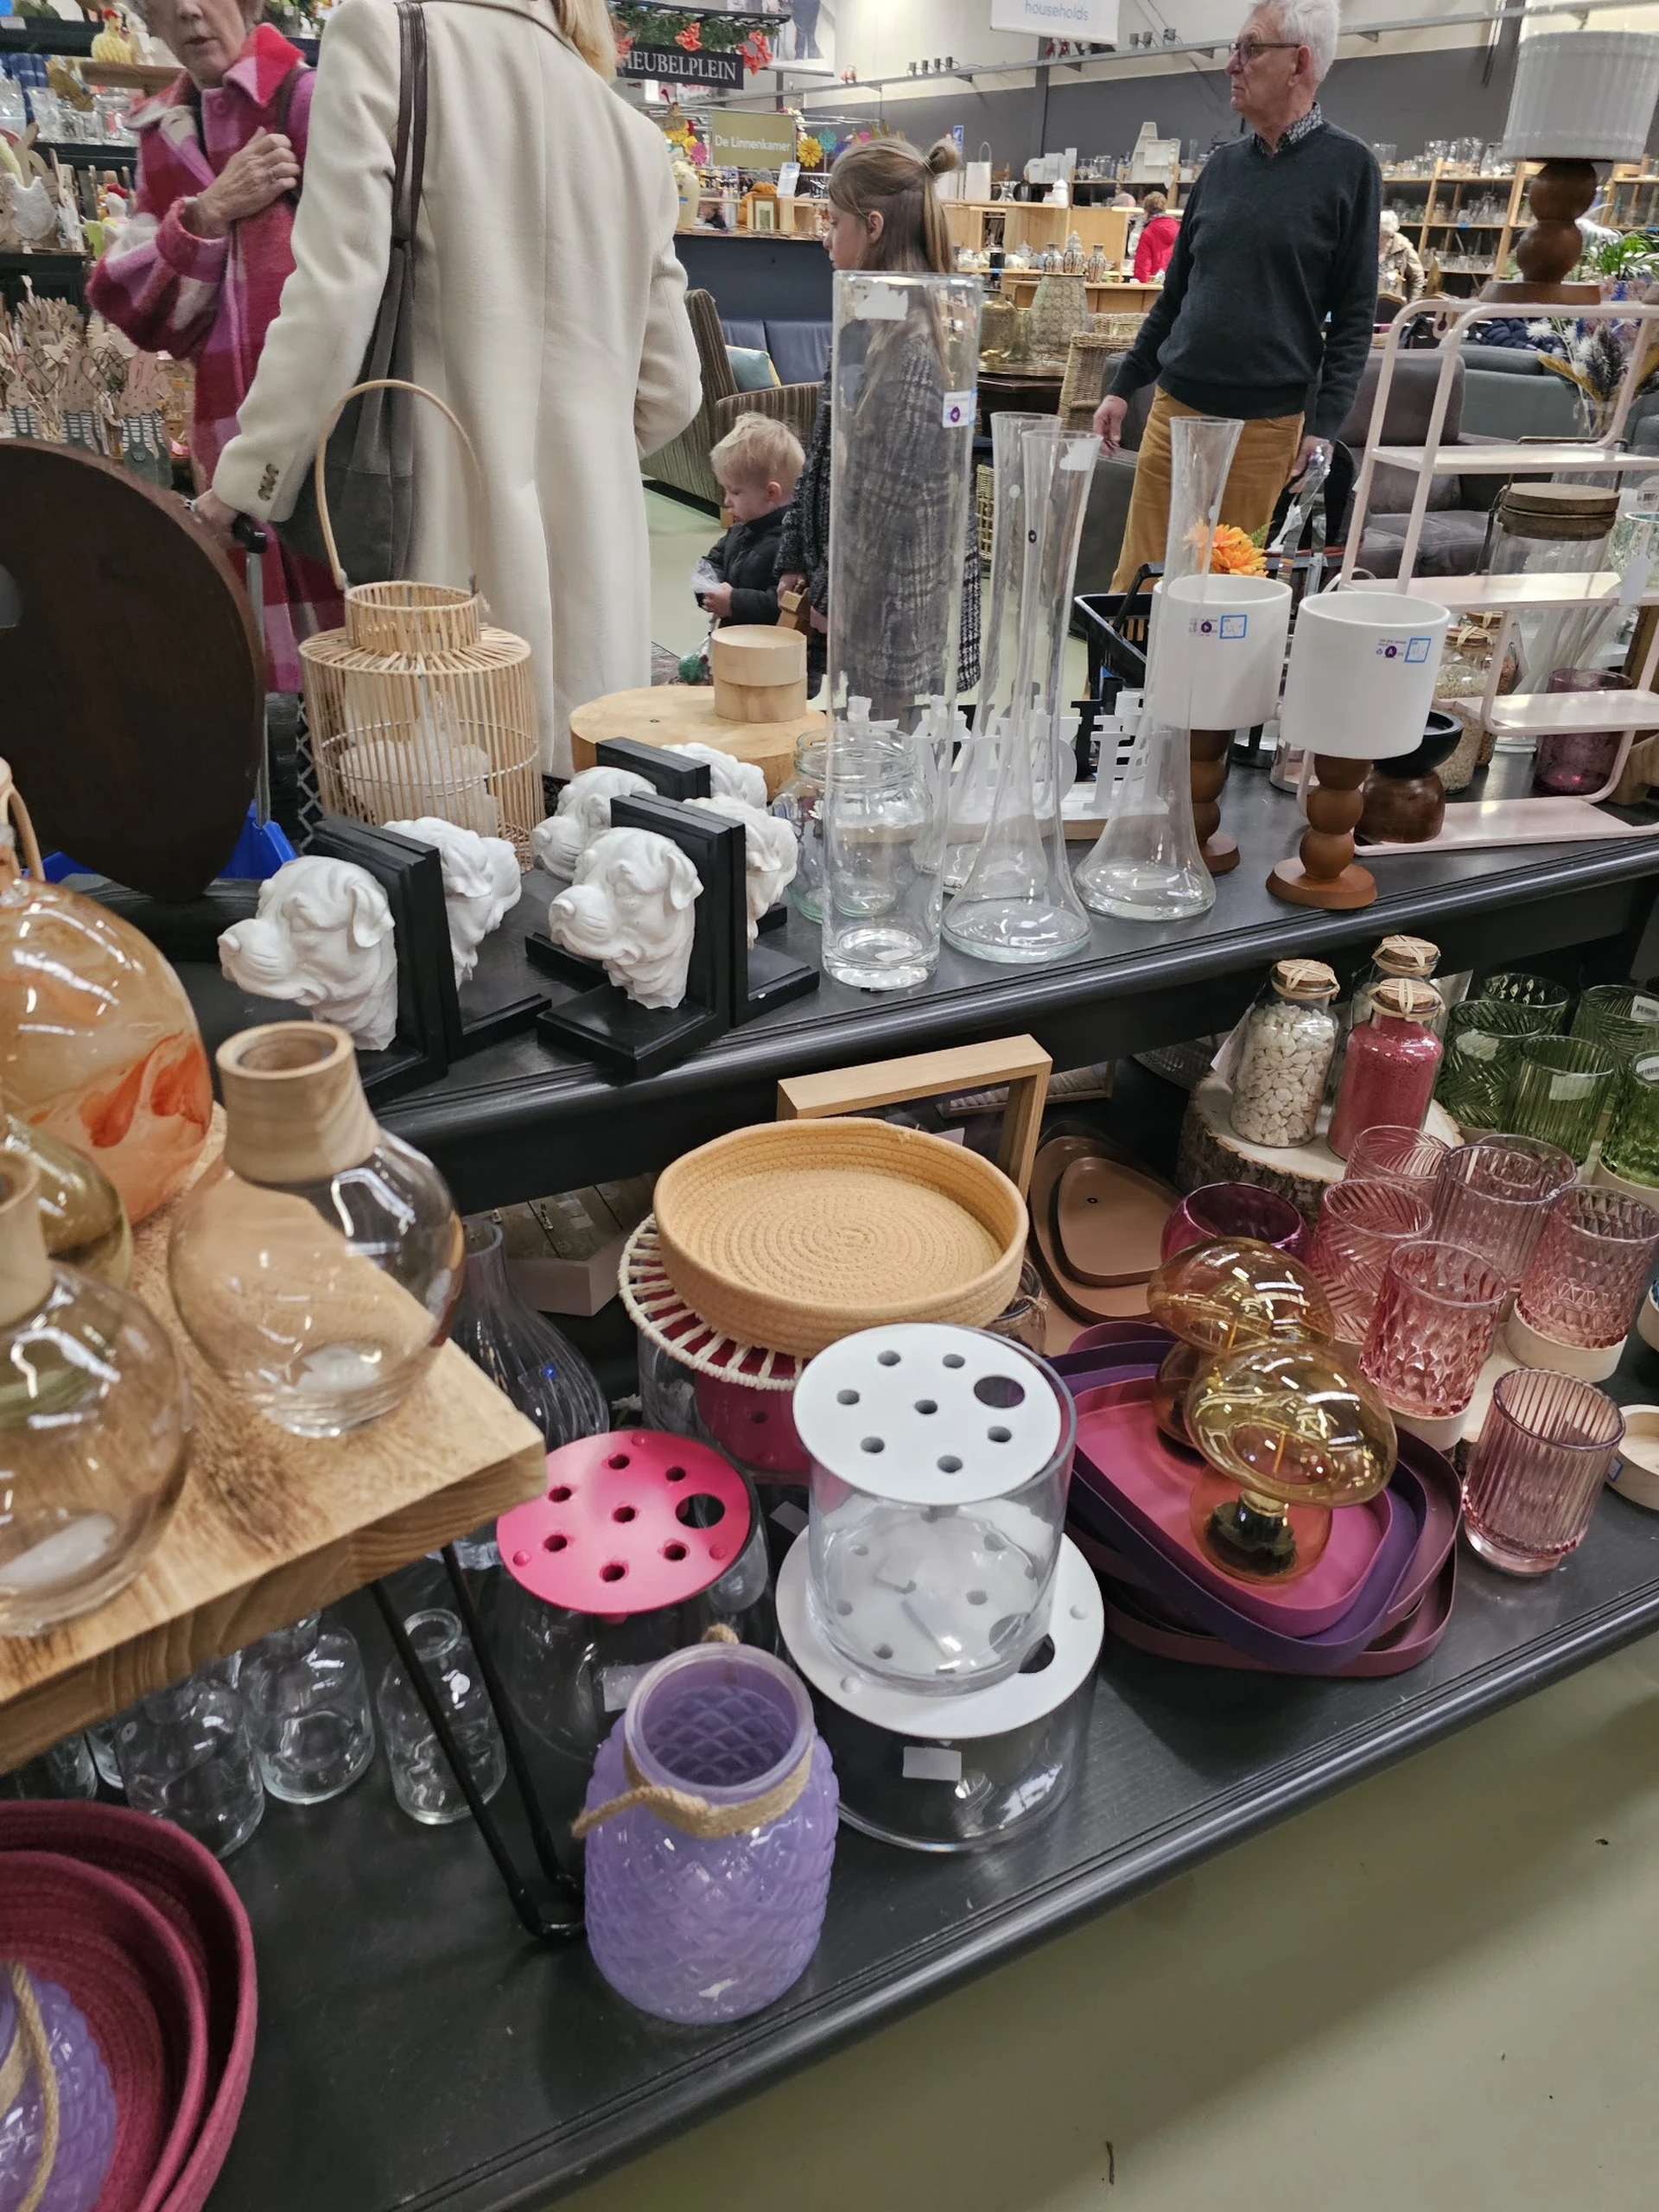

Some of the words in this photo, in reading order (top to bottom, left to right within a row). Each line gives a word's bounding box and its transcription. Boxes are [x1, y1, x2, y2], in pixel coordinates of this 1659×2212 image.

[1025, 1, 1089, 21] households
[715, 135, 729, 147] De
[731, 137, 791, 151] Linnenkamer
